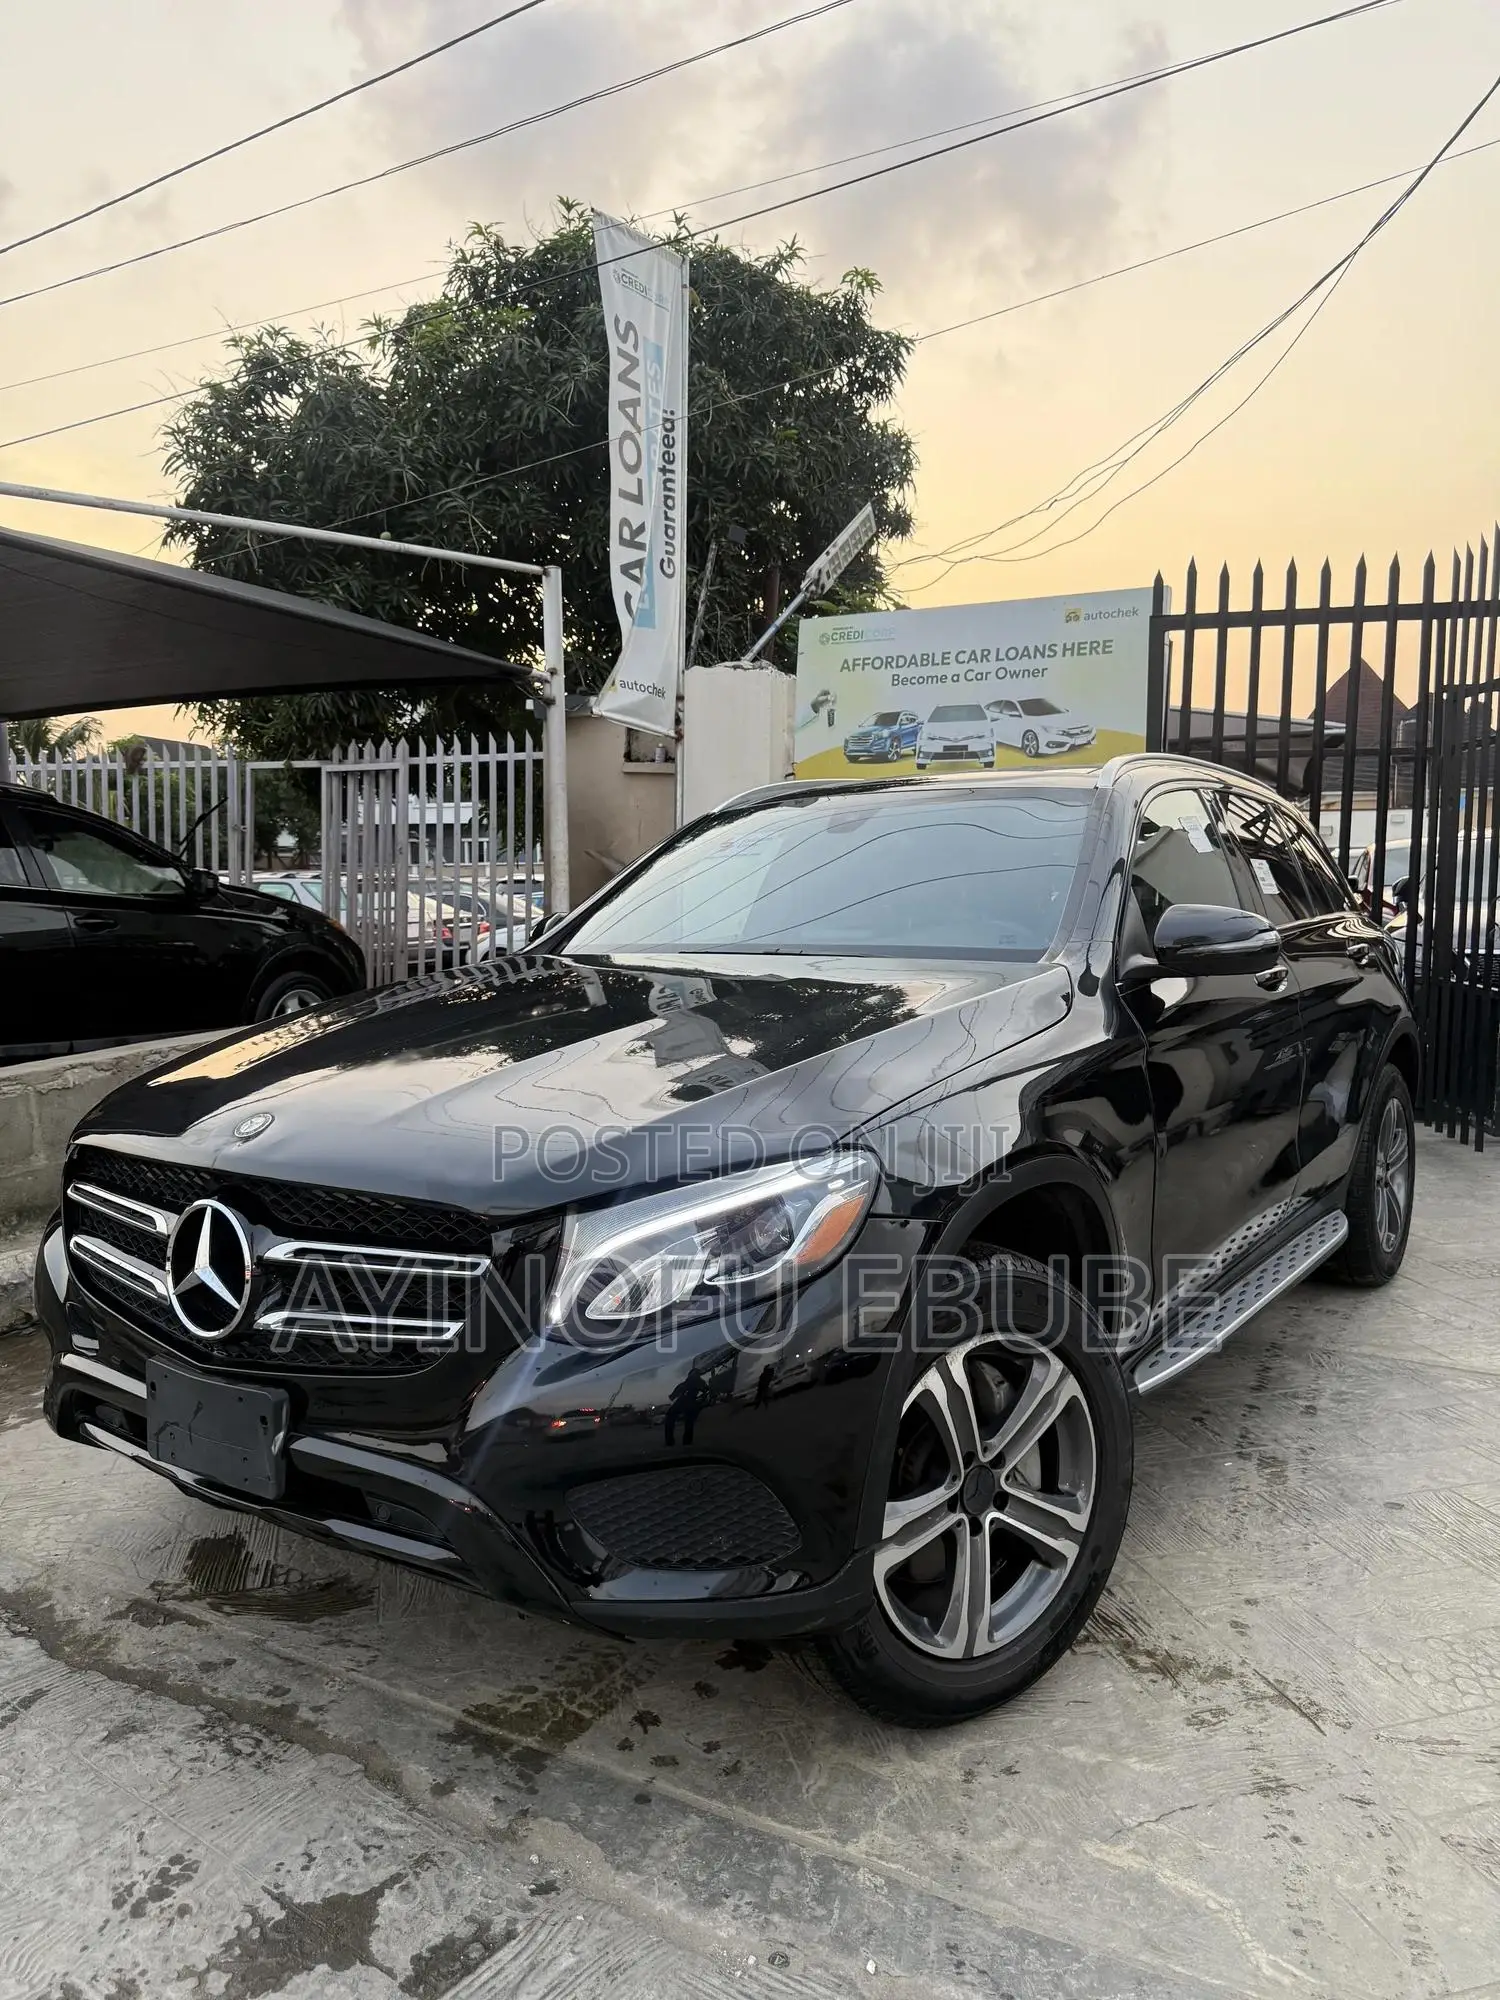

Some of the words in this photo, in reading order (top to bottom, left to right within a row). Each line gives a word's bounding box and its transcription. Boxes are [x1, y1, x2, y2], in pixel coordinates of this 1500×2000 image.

[614, 313, 644, 507] LOANS
[1083, 607, 1140, 621] autochek
[840, 651, 951, 672] AFFORDABLE
[954, 648, 991, 664] CAR
[995, 643, 1058, 662] LOANS
[1061, 639, 1114, 657] HERE
[891, 673, 948, 686] Become
[951, 673, 960, 683] a
[964, 668, 991, 682] Car
[995, 666, 1048, 680] Owner
[619, 680, 666, 700] autochek
